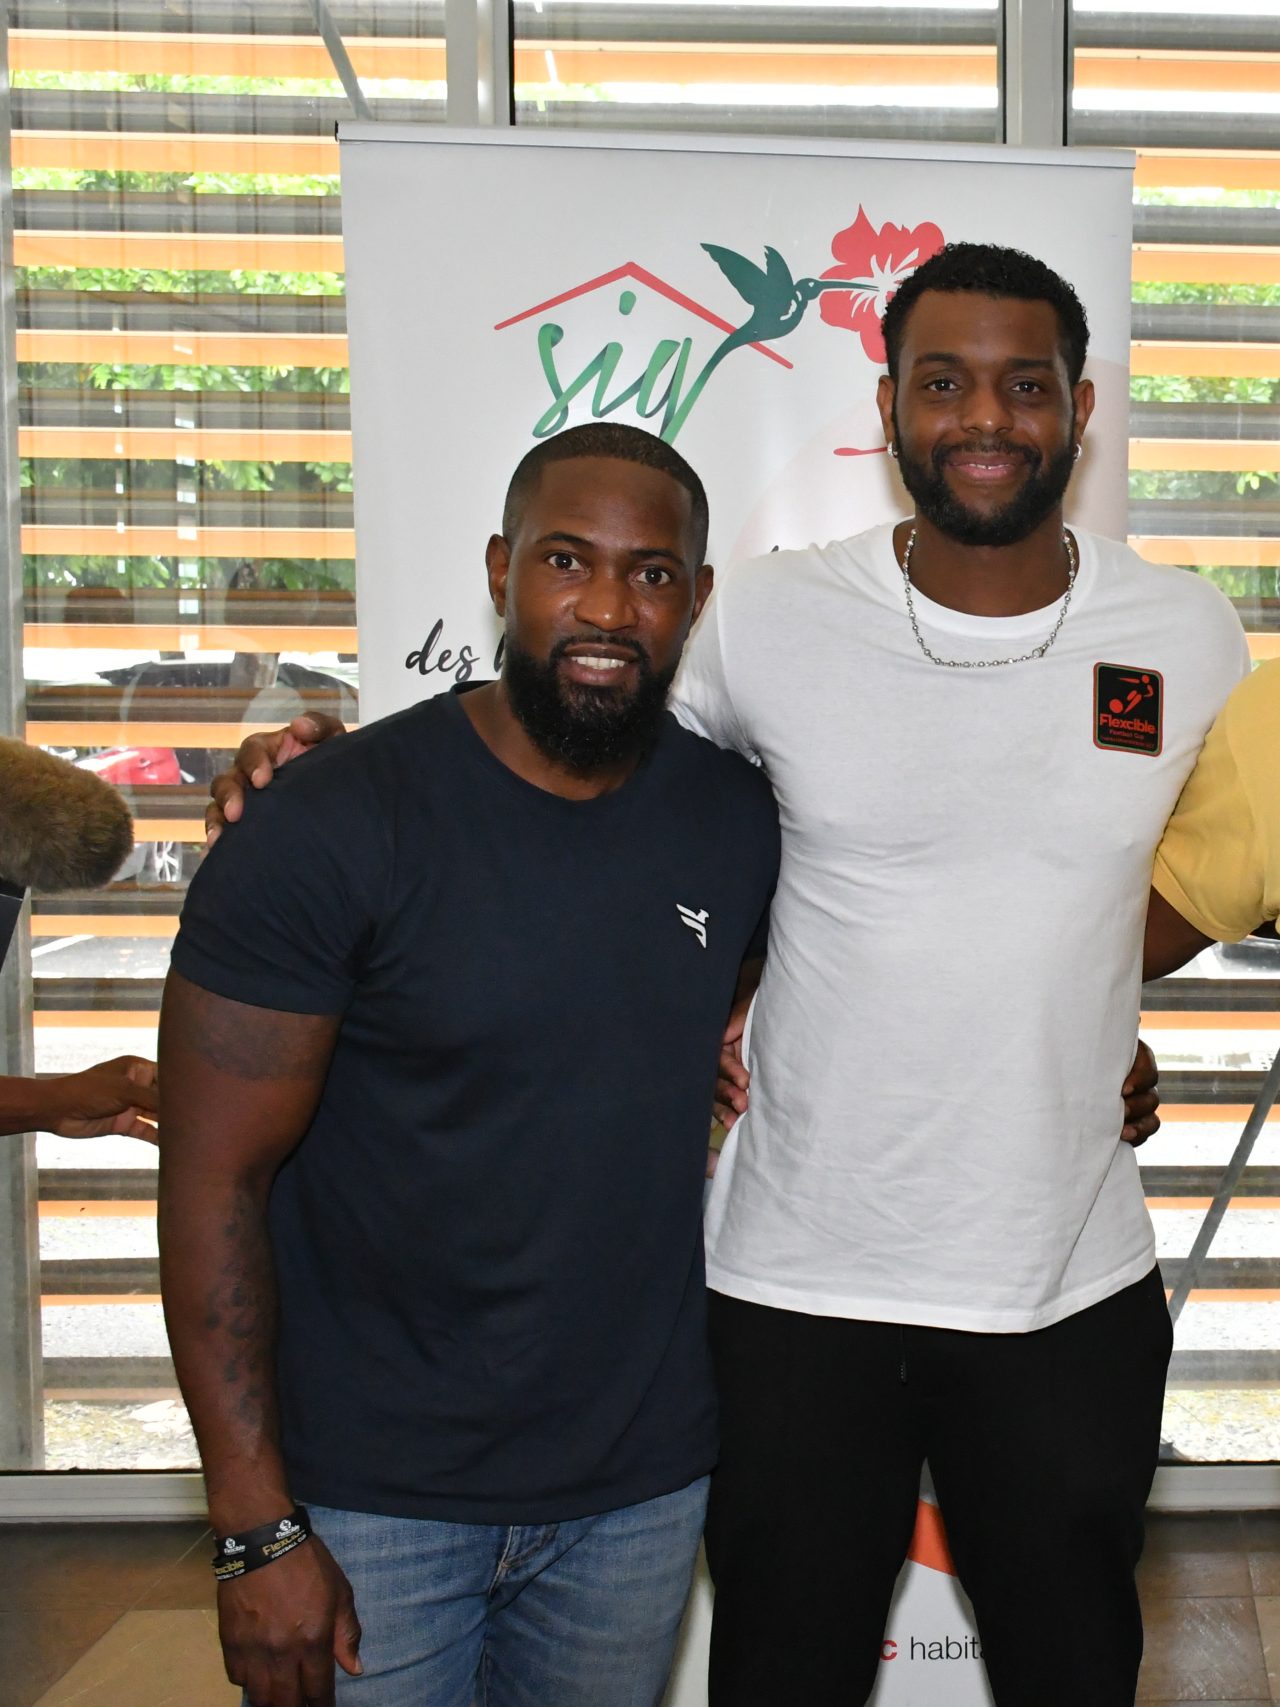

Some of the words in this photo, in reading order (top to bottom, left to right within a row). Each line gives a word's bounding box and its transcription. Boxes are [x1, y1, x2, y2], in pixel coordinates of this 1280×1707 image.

[405, 618, 480, 682] des
[1100, 713, 1156, 735] Flexcible
[910, 1635, 984, 1661] habit
